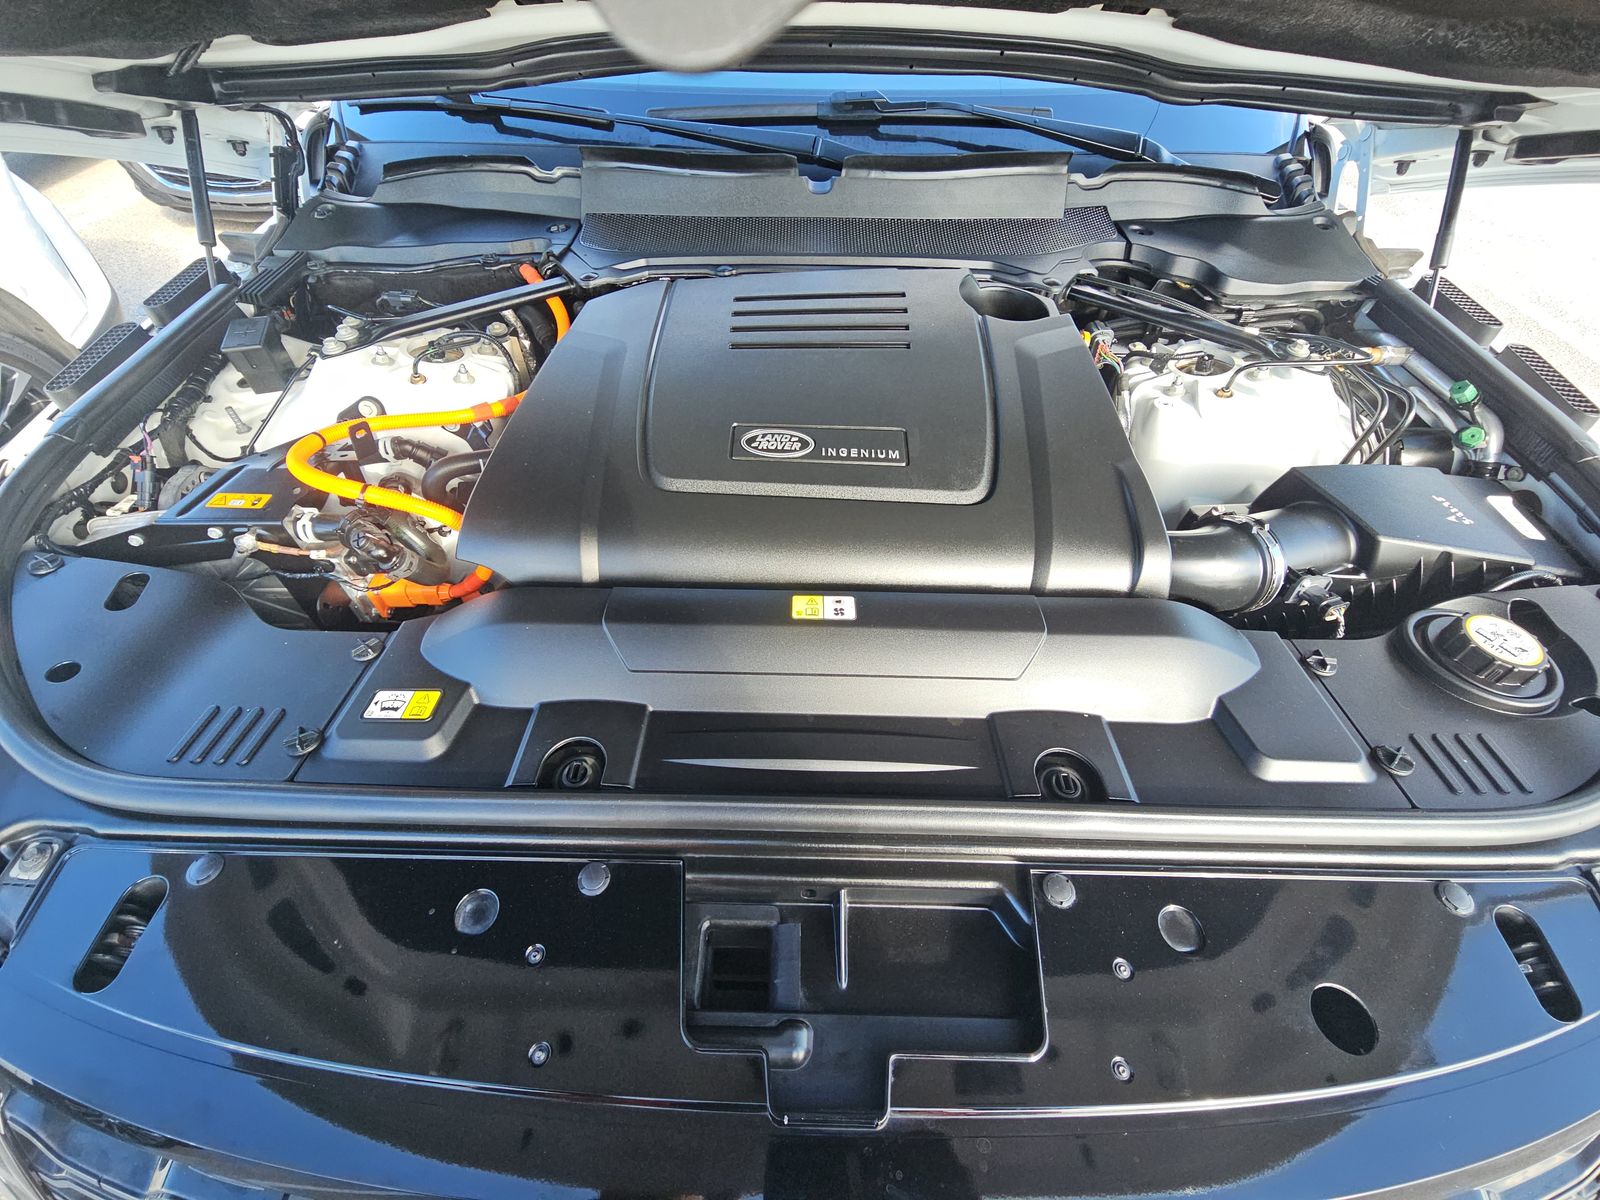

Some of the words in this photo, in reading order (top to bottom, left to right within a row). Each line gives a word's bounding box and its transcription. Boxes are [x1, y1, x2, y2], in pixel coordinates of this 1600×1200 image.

[756, 434, 790, 442] LAND
[758, 441, 801, 451] ROVER
[821, 447, 900, 459] INGENIUM
